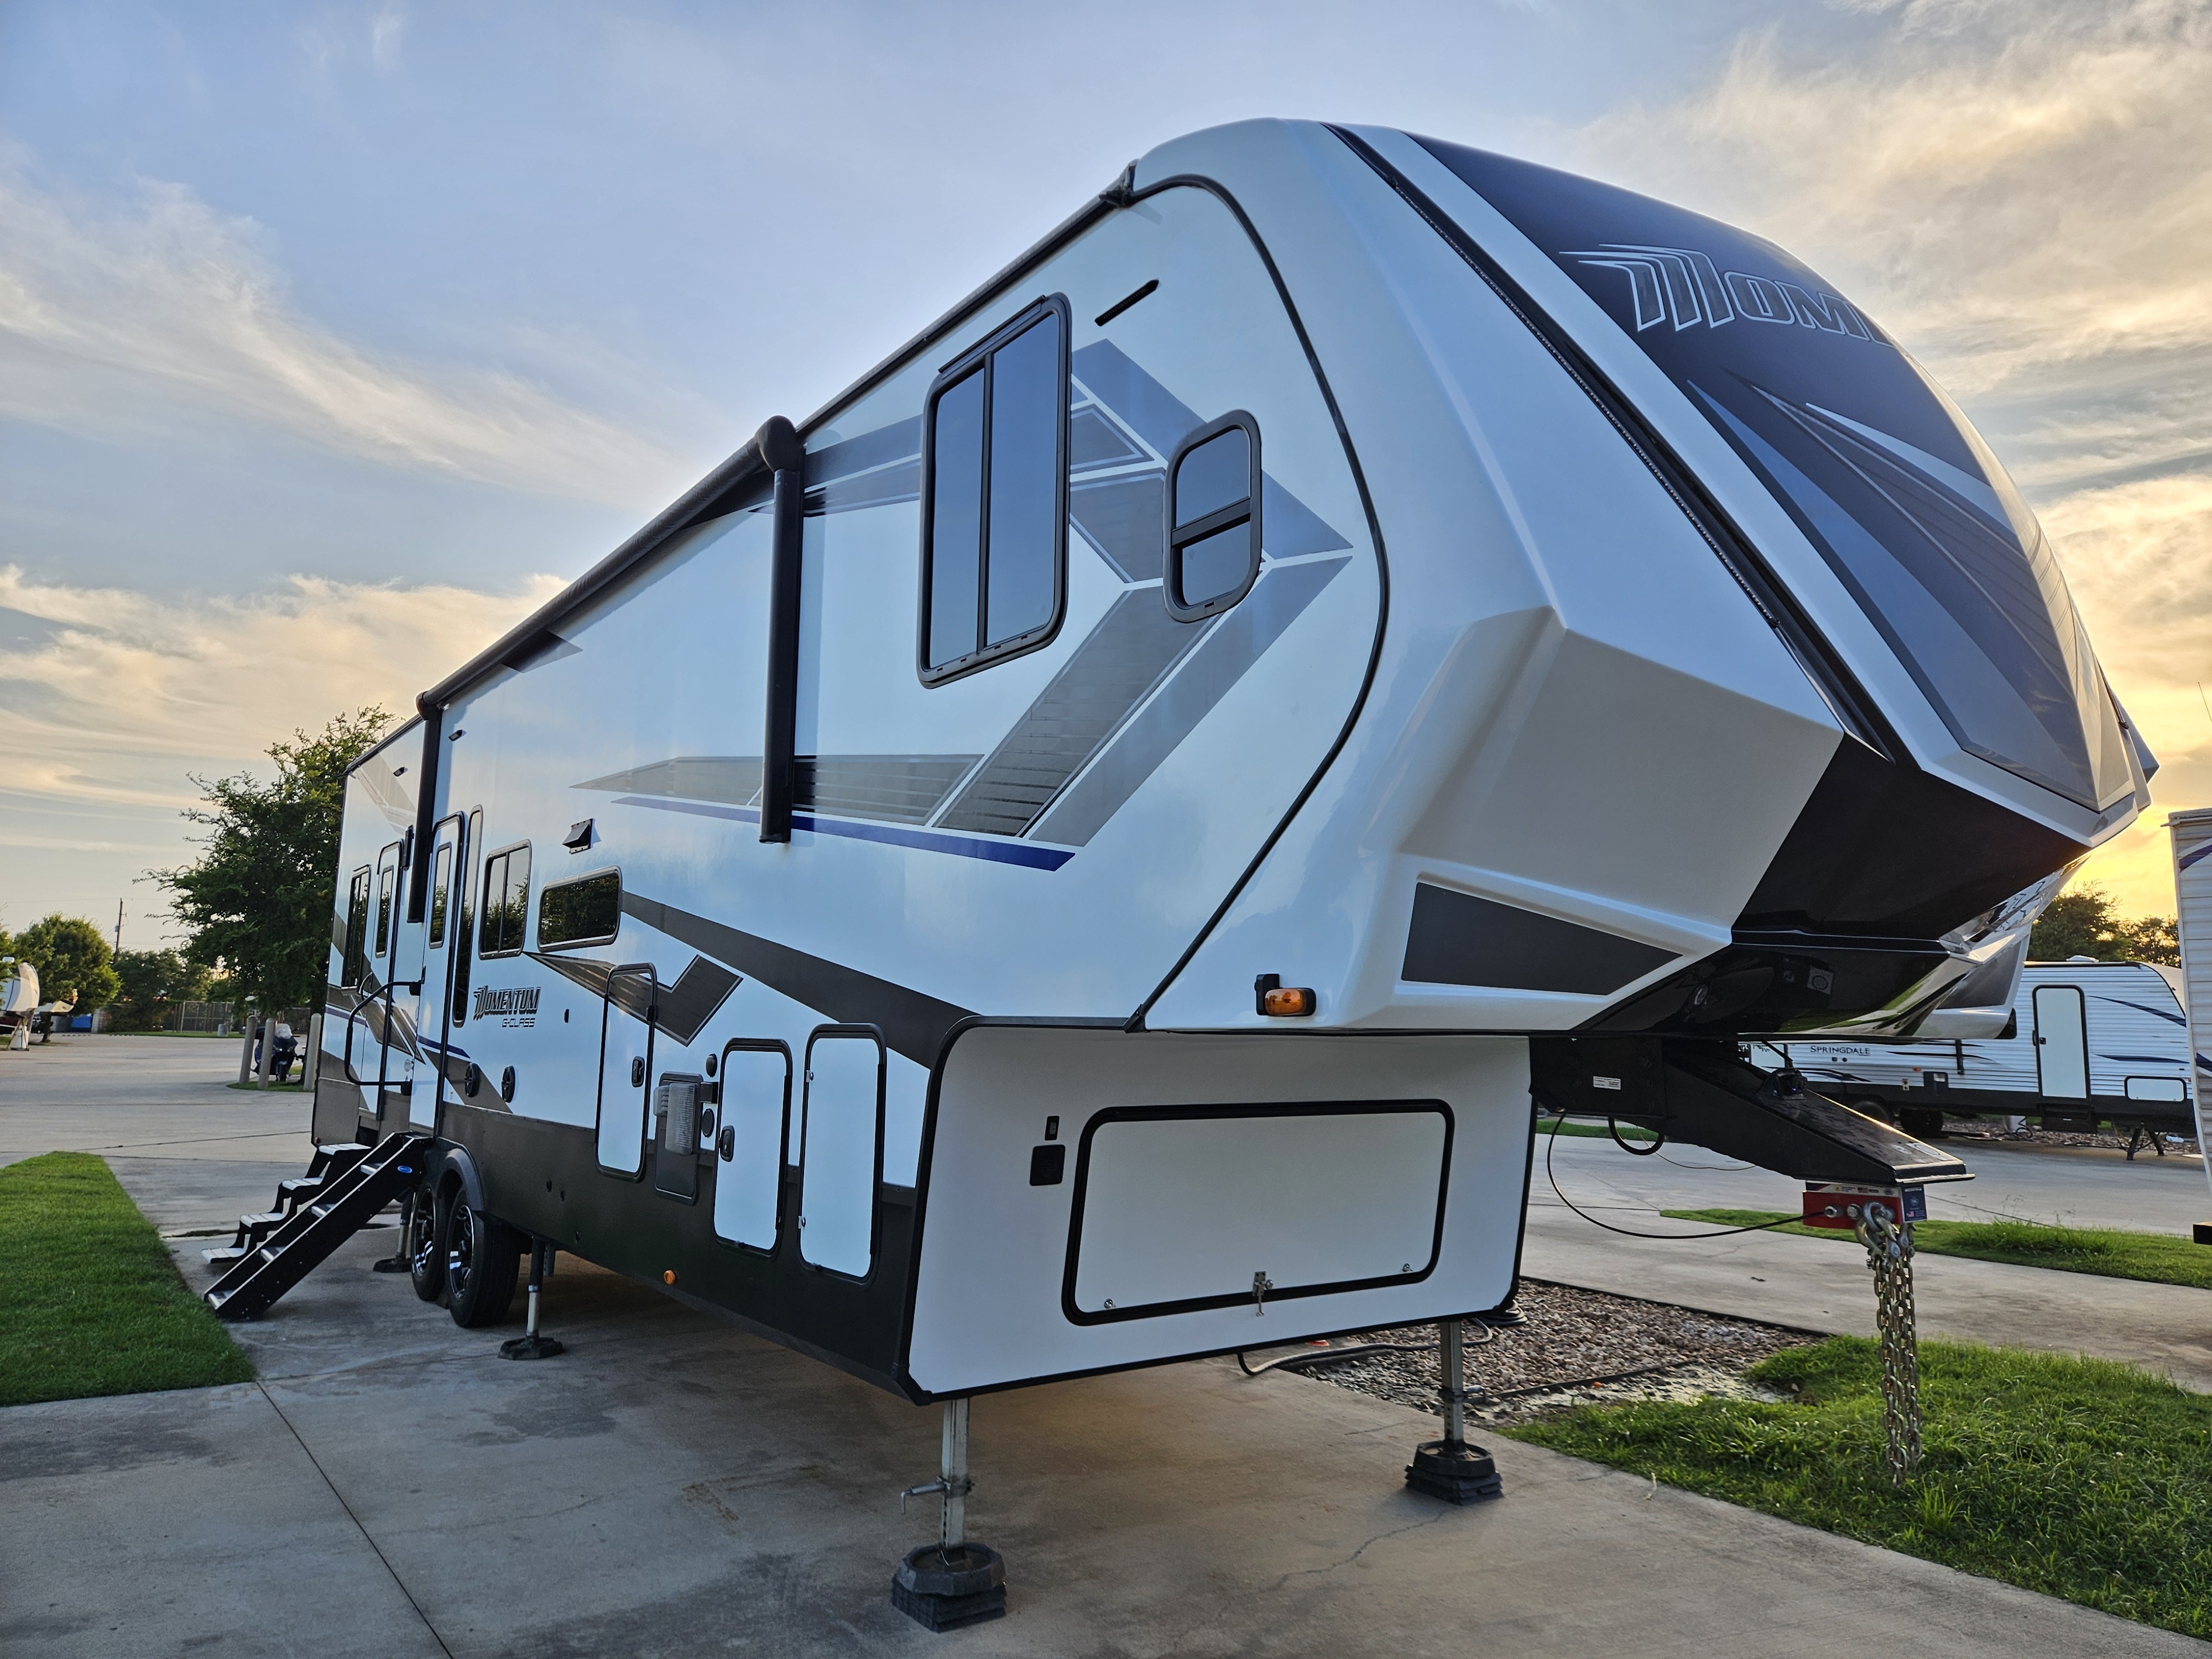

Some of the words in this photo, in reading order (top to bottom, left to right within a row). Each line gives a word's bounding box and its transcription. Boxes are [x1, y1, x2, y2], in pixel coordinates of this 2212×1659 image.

[473, 985, 541, 1021] MOMENTUM
[502, 1018, 535, 1027] G-CLASS
[1810, 1045, 1870, 1054] SPRINGDALE
